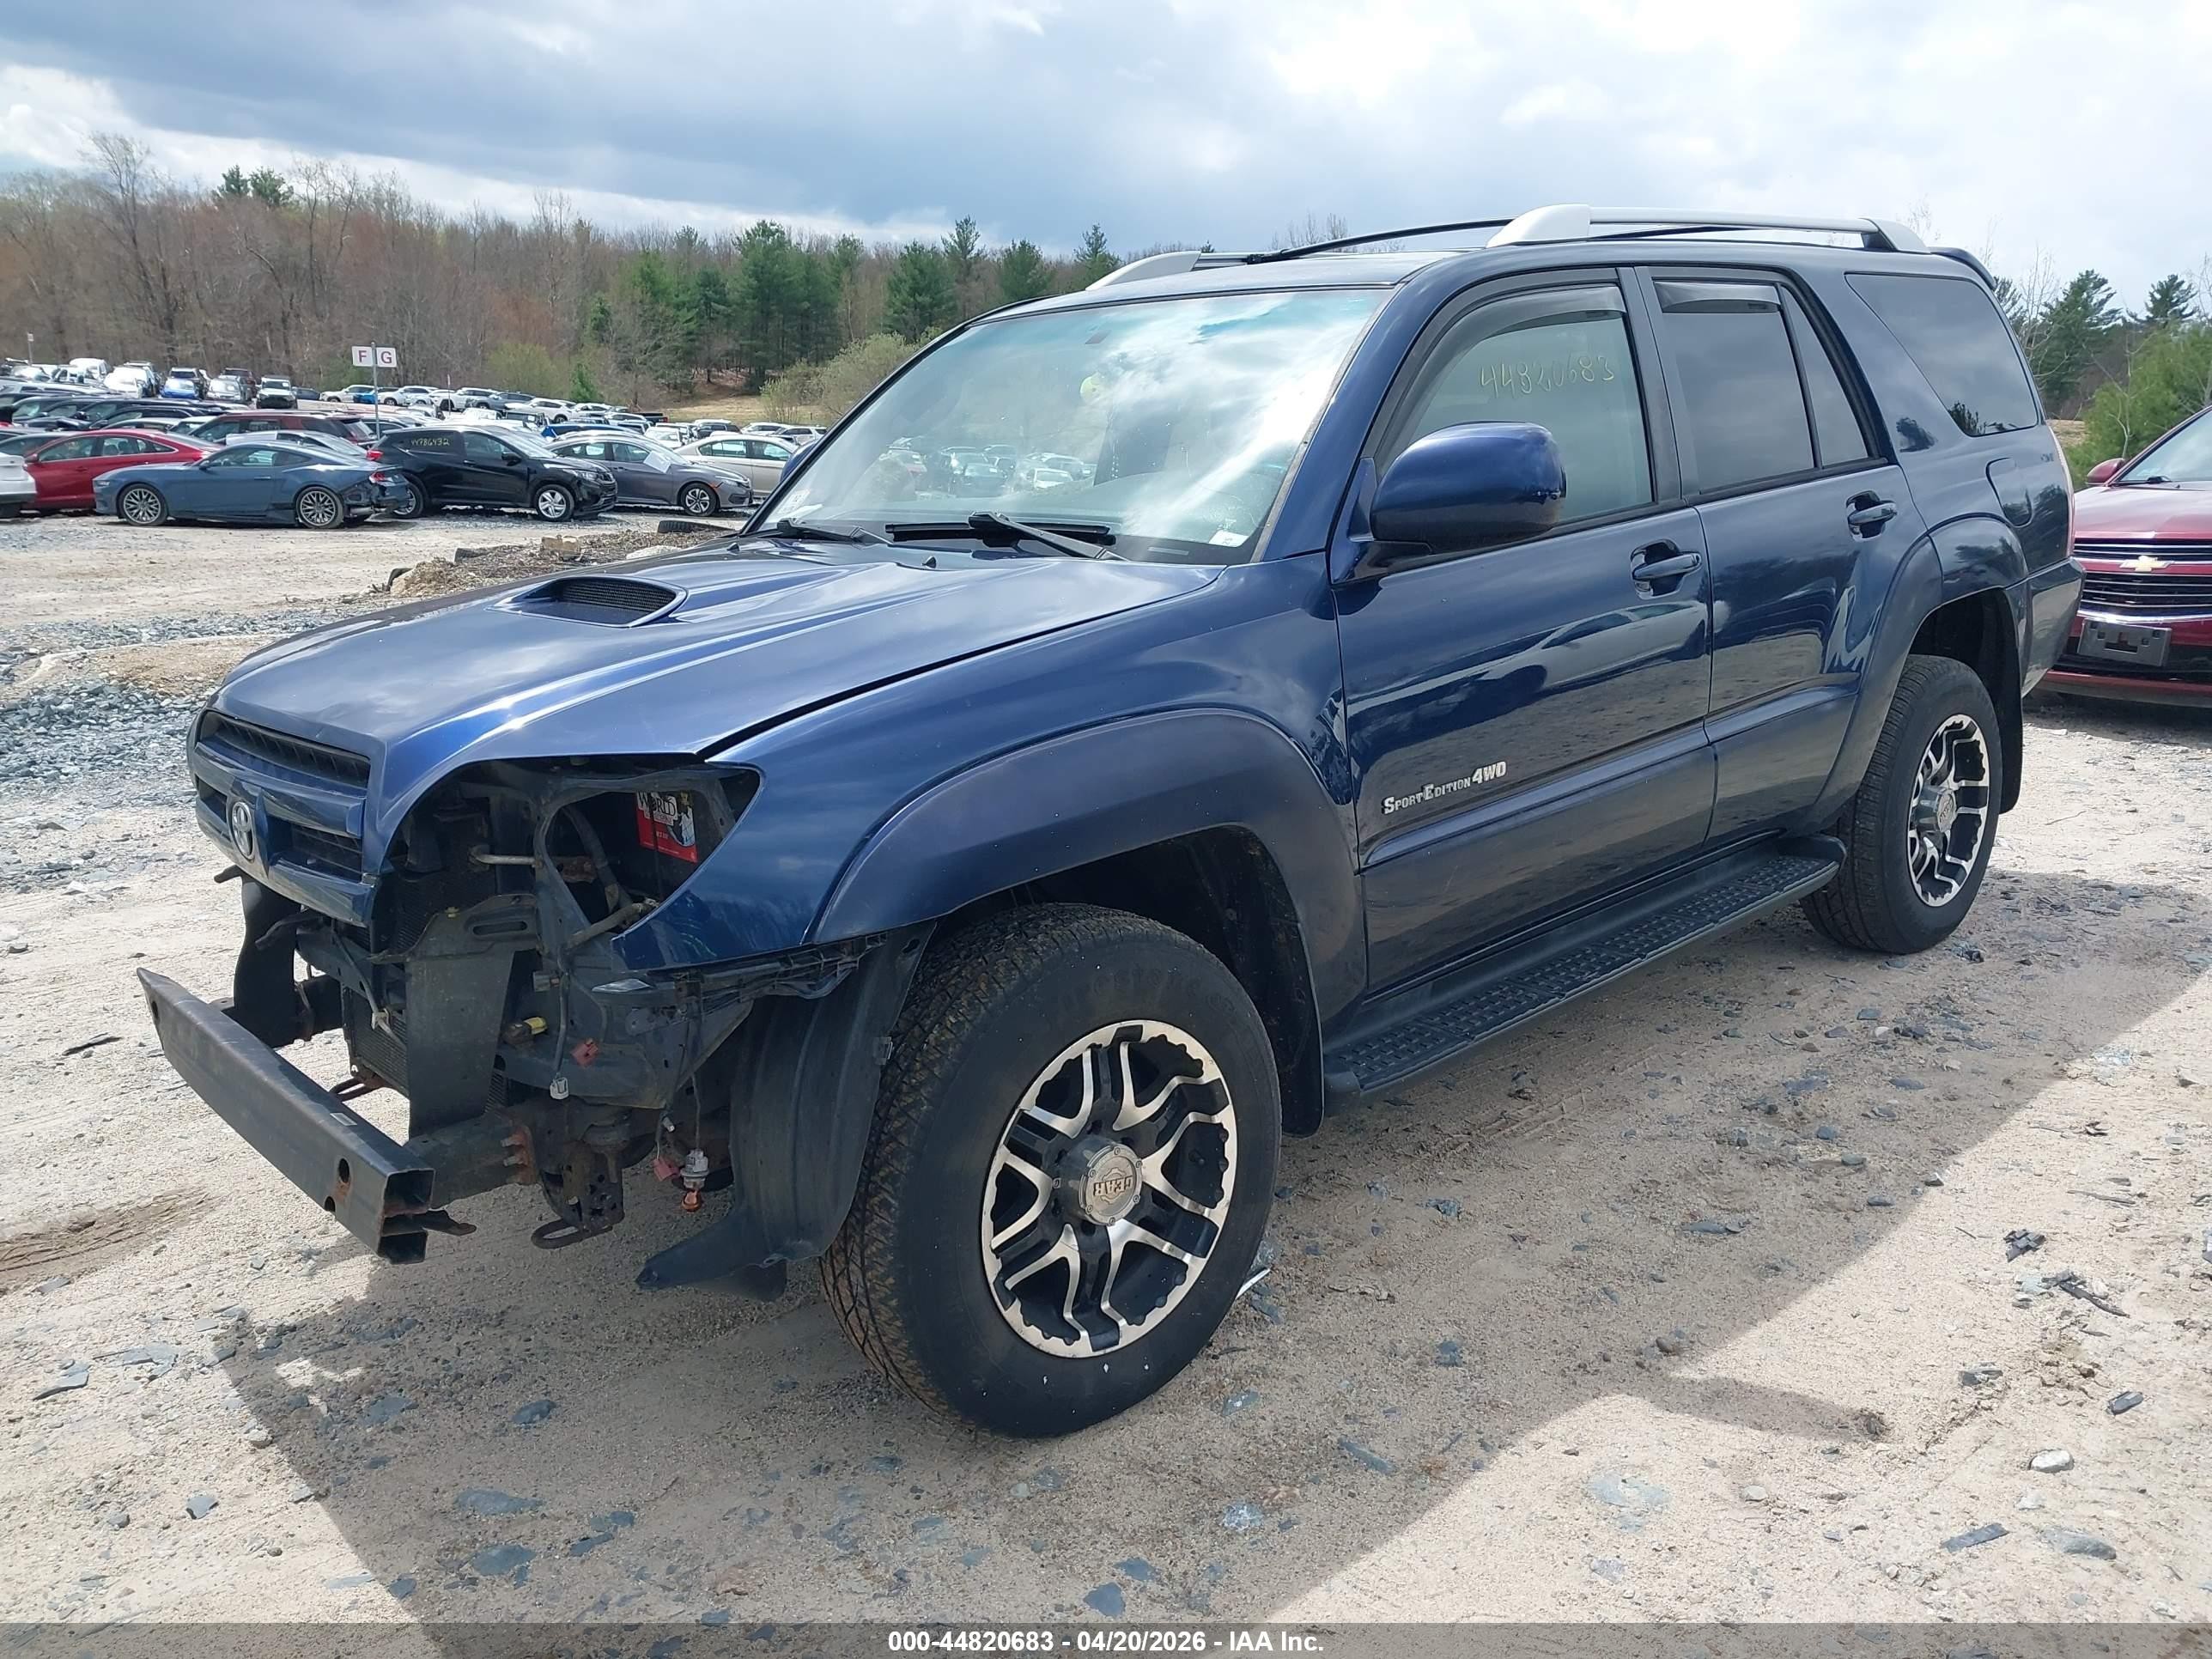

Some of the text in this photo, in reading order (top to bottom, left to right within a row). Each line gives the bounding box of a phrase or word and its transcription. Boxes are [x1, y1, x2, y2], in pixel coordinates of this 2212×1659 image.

[358, 349, 368, 363] F
[380, 350, 392, 364] G
[1480, 351, 1615, 398] 44820683
[1471, 761, 1508, 785] 4WD
